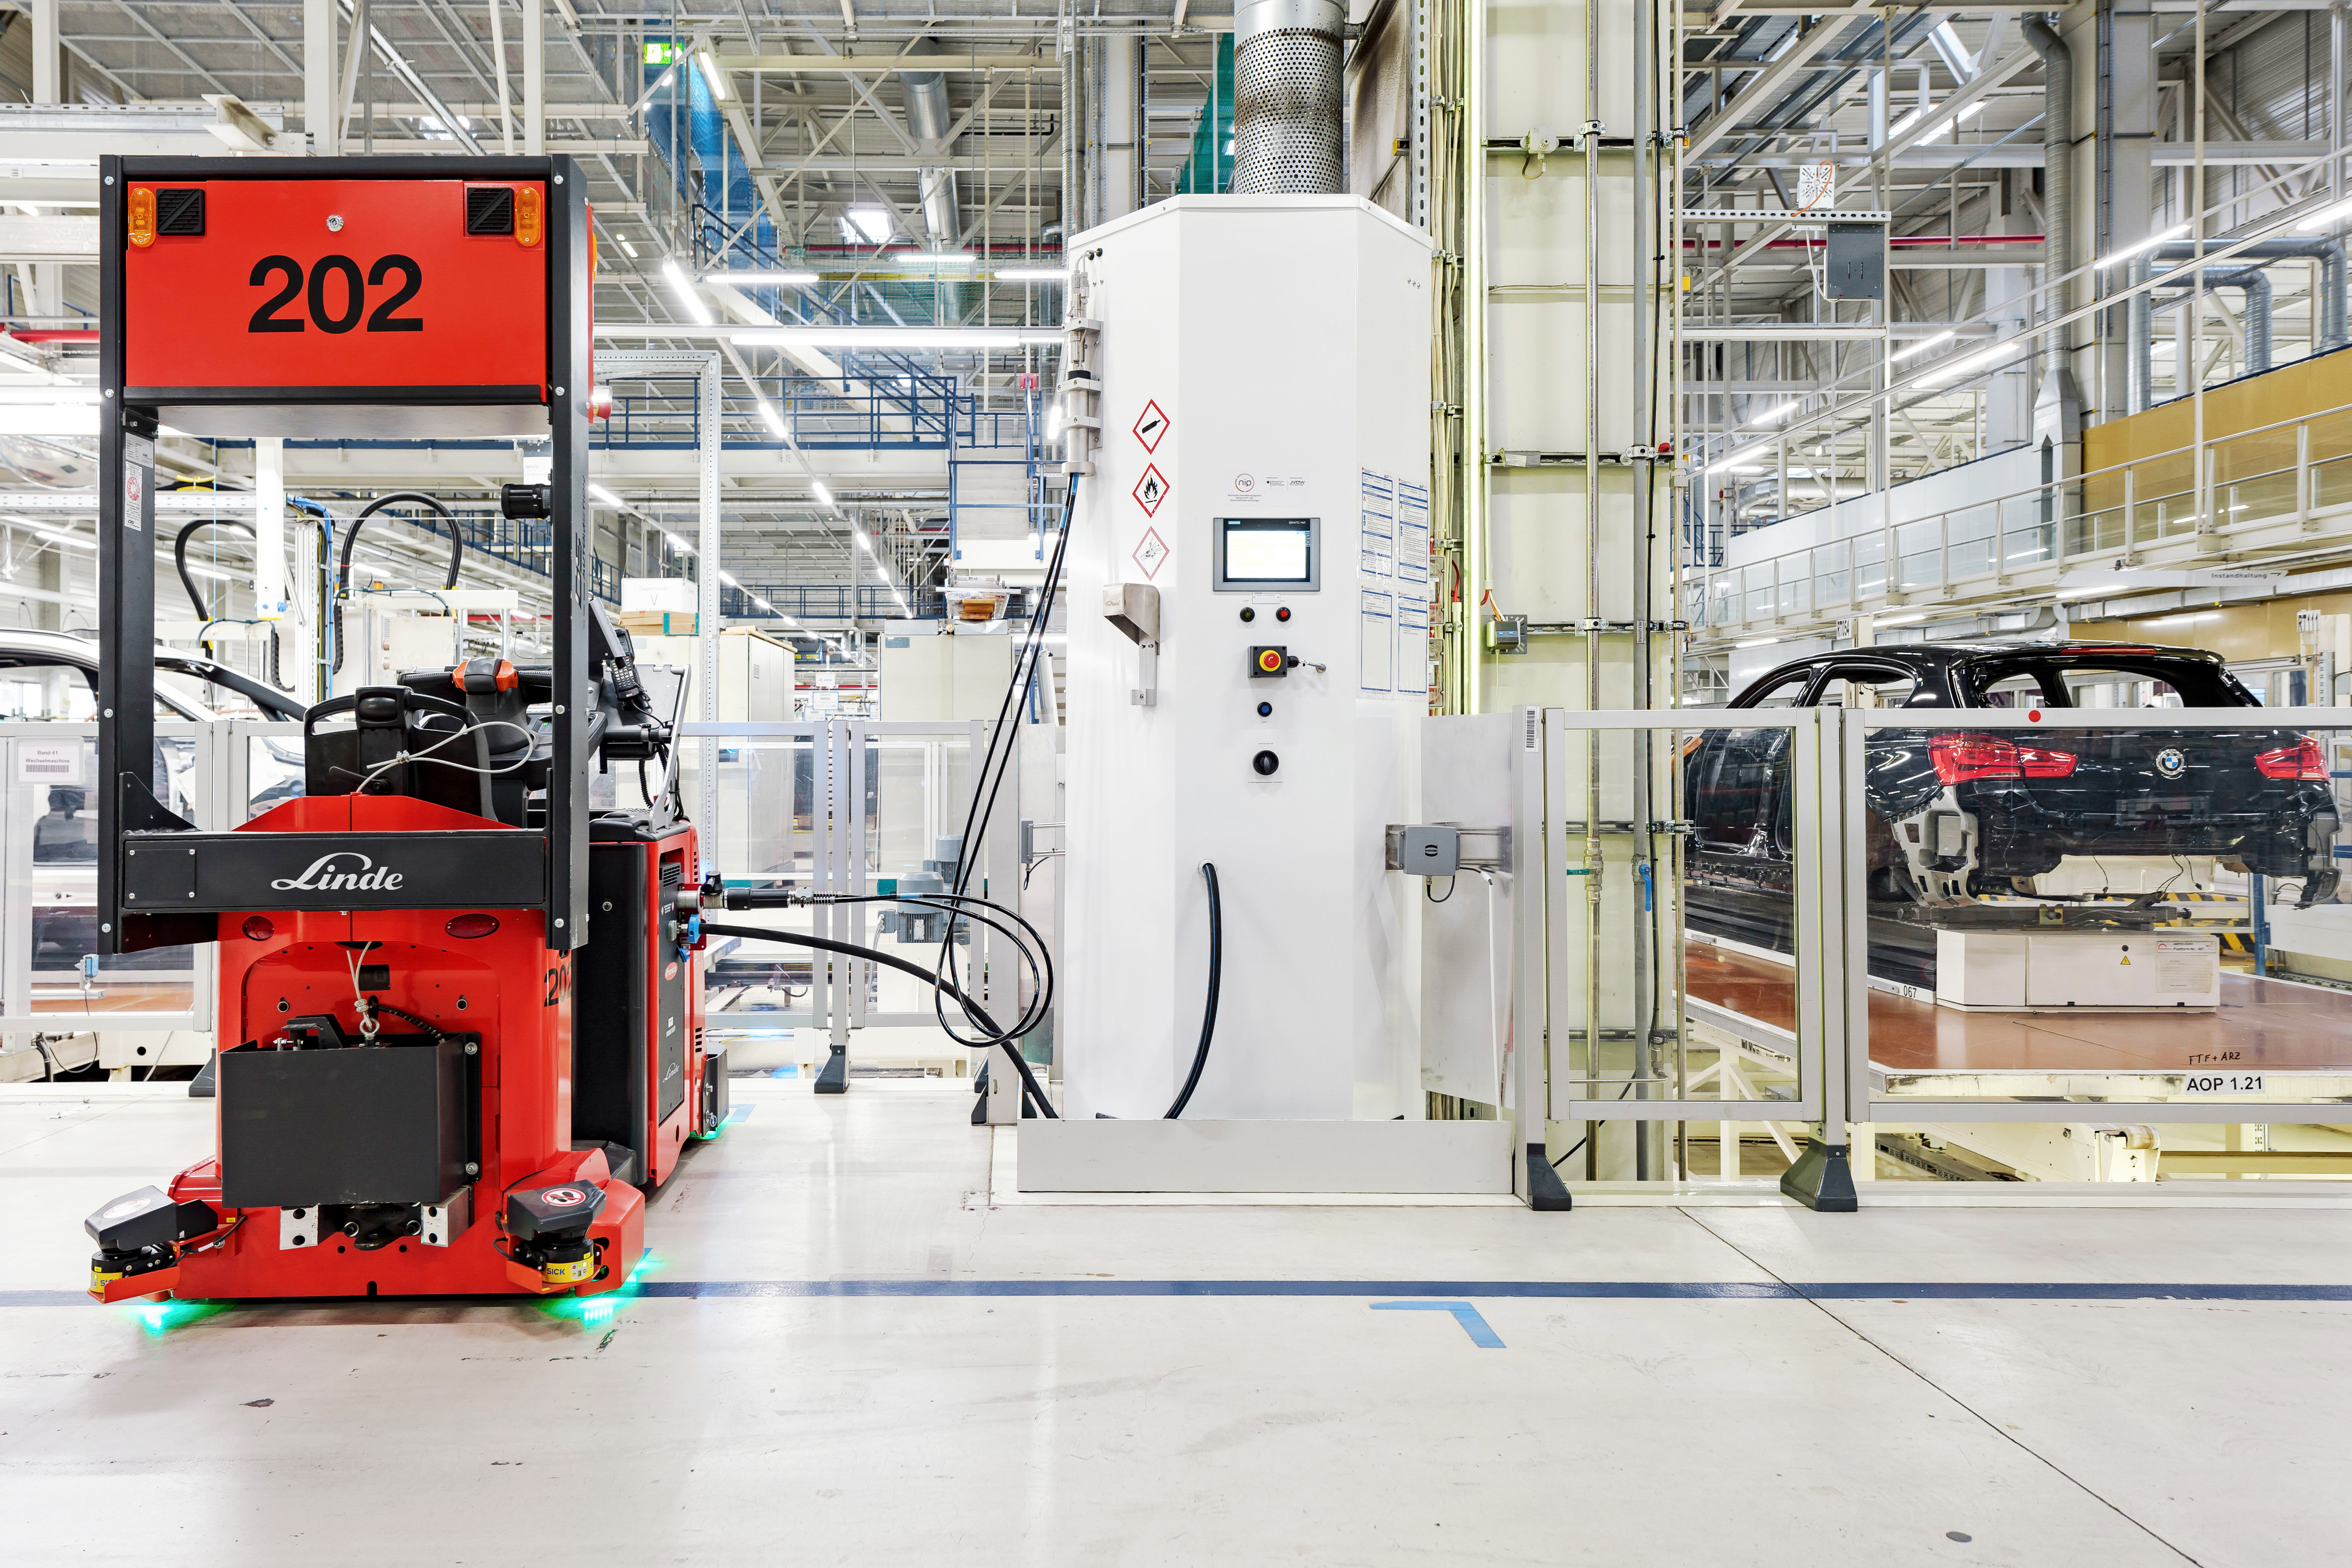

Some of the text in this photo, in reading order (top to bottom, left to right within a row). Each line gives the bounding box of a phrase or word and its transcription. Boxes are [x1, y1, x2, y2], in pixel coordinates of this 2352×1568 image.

[248, 254, 423, 334] 202
[1239, 479, 1252, 487] nip
[271, 852, 403, 890] Linde
[1903, 985, 1917, 998] 067
[2221, 1052, 2240, 1061] ARZ
[662, 1063, 680, 1083] Linde
[2187, 1077, 2261, 1091] AOP 1.21
